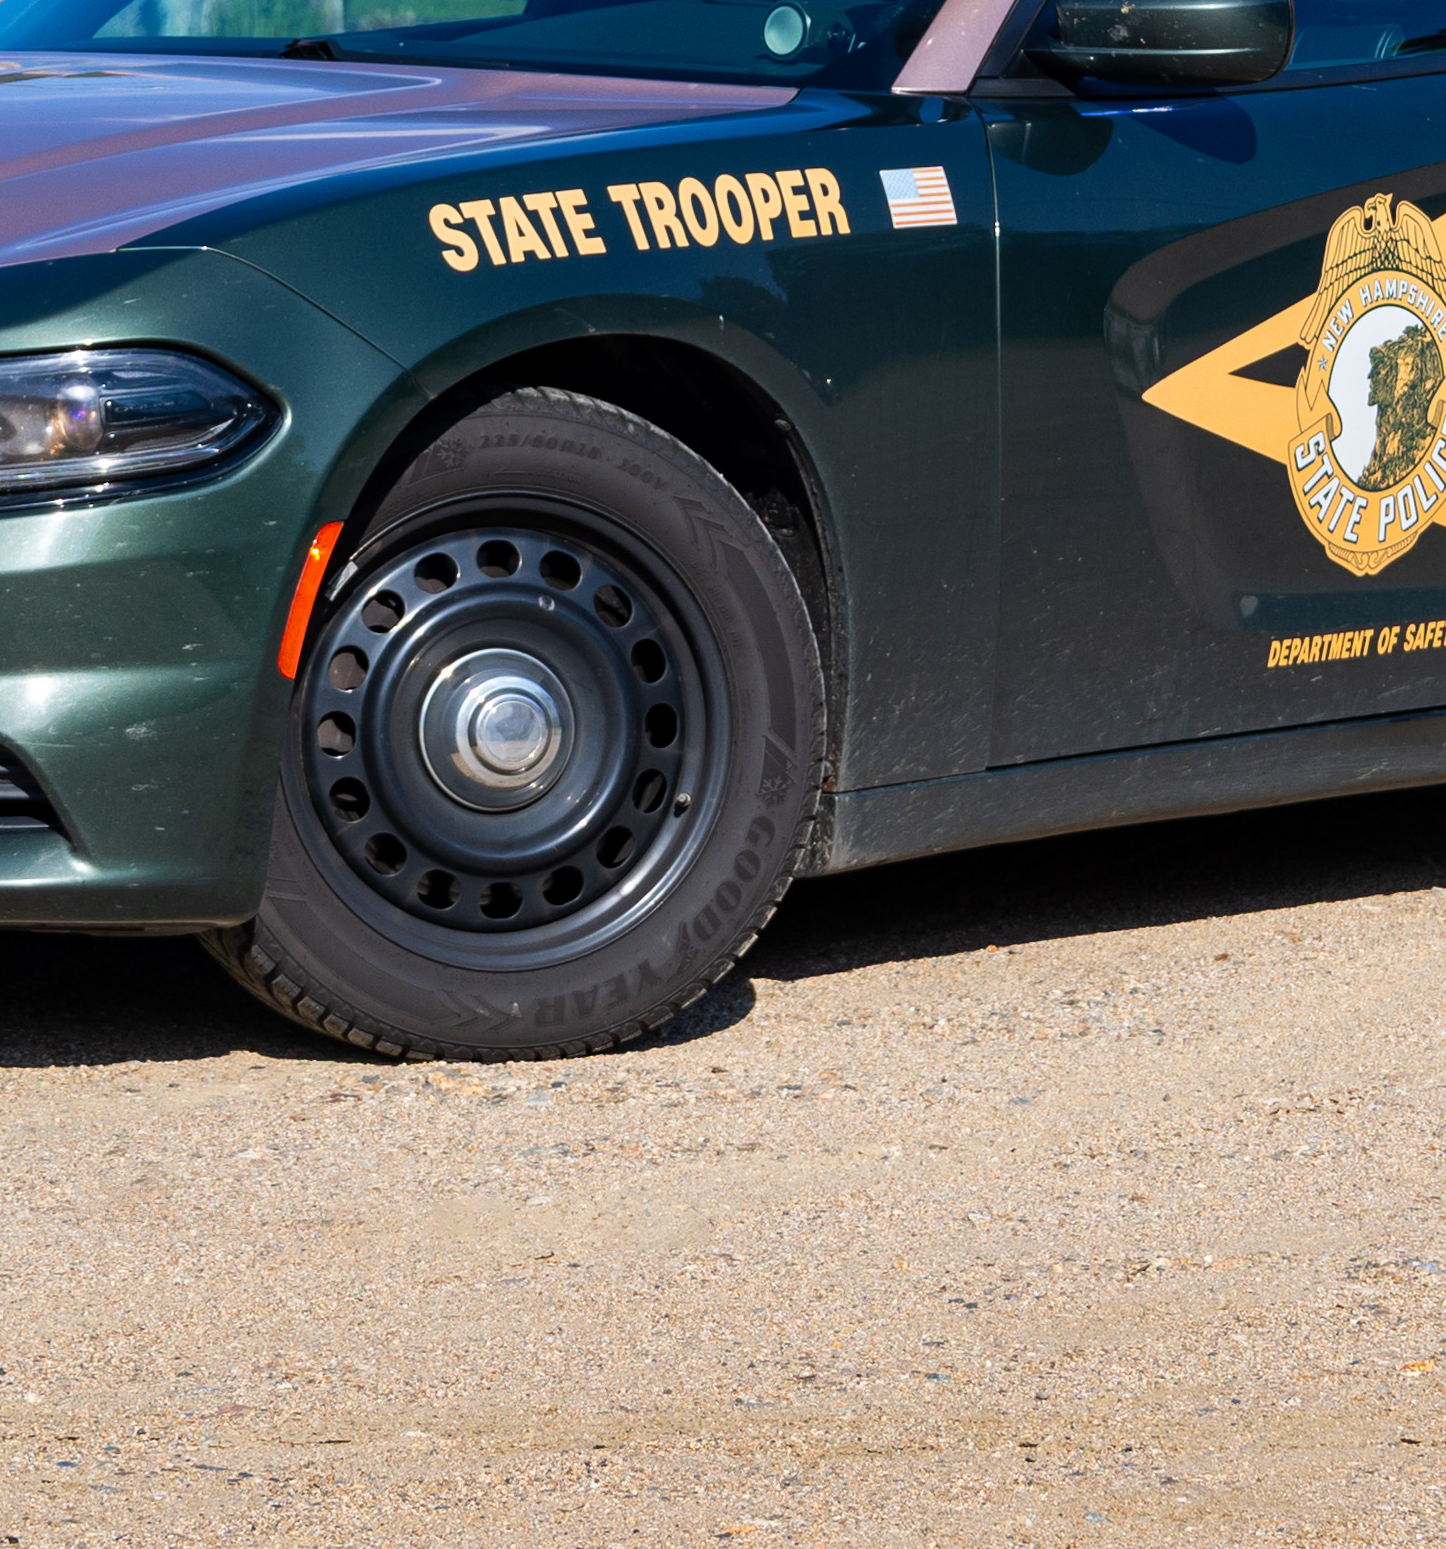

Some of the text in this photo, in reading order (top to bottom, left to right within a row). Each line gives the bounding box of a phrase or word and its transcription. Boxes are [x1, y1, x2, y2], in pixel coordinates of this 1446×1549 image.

[428, 167, 851, 272] STATE TROOPER
[1321, 299, 1354, 352] NEW
[1294, 430, 1368, 543] STATE
[1267, 628, 1374, 668] DEPARTMENT
[1377, 625, 1400, 655] OF
